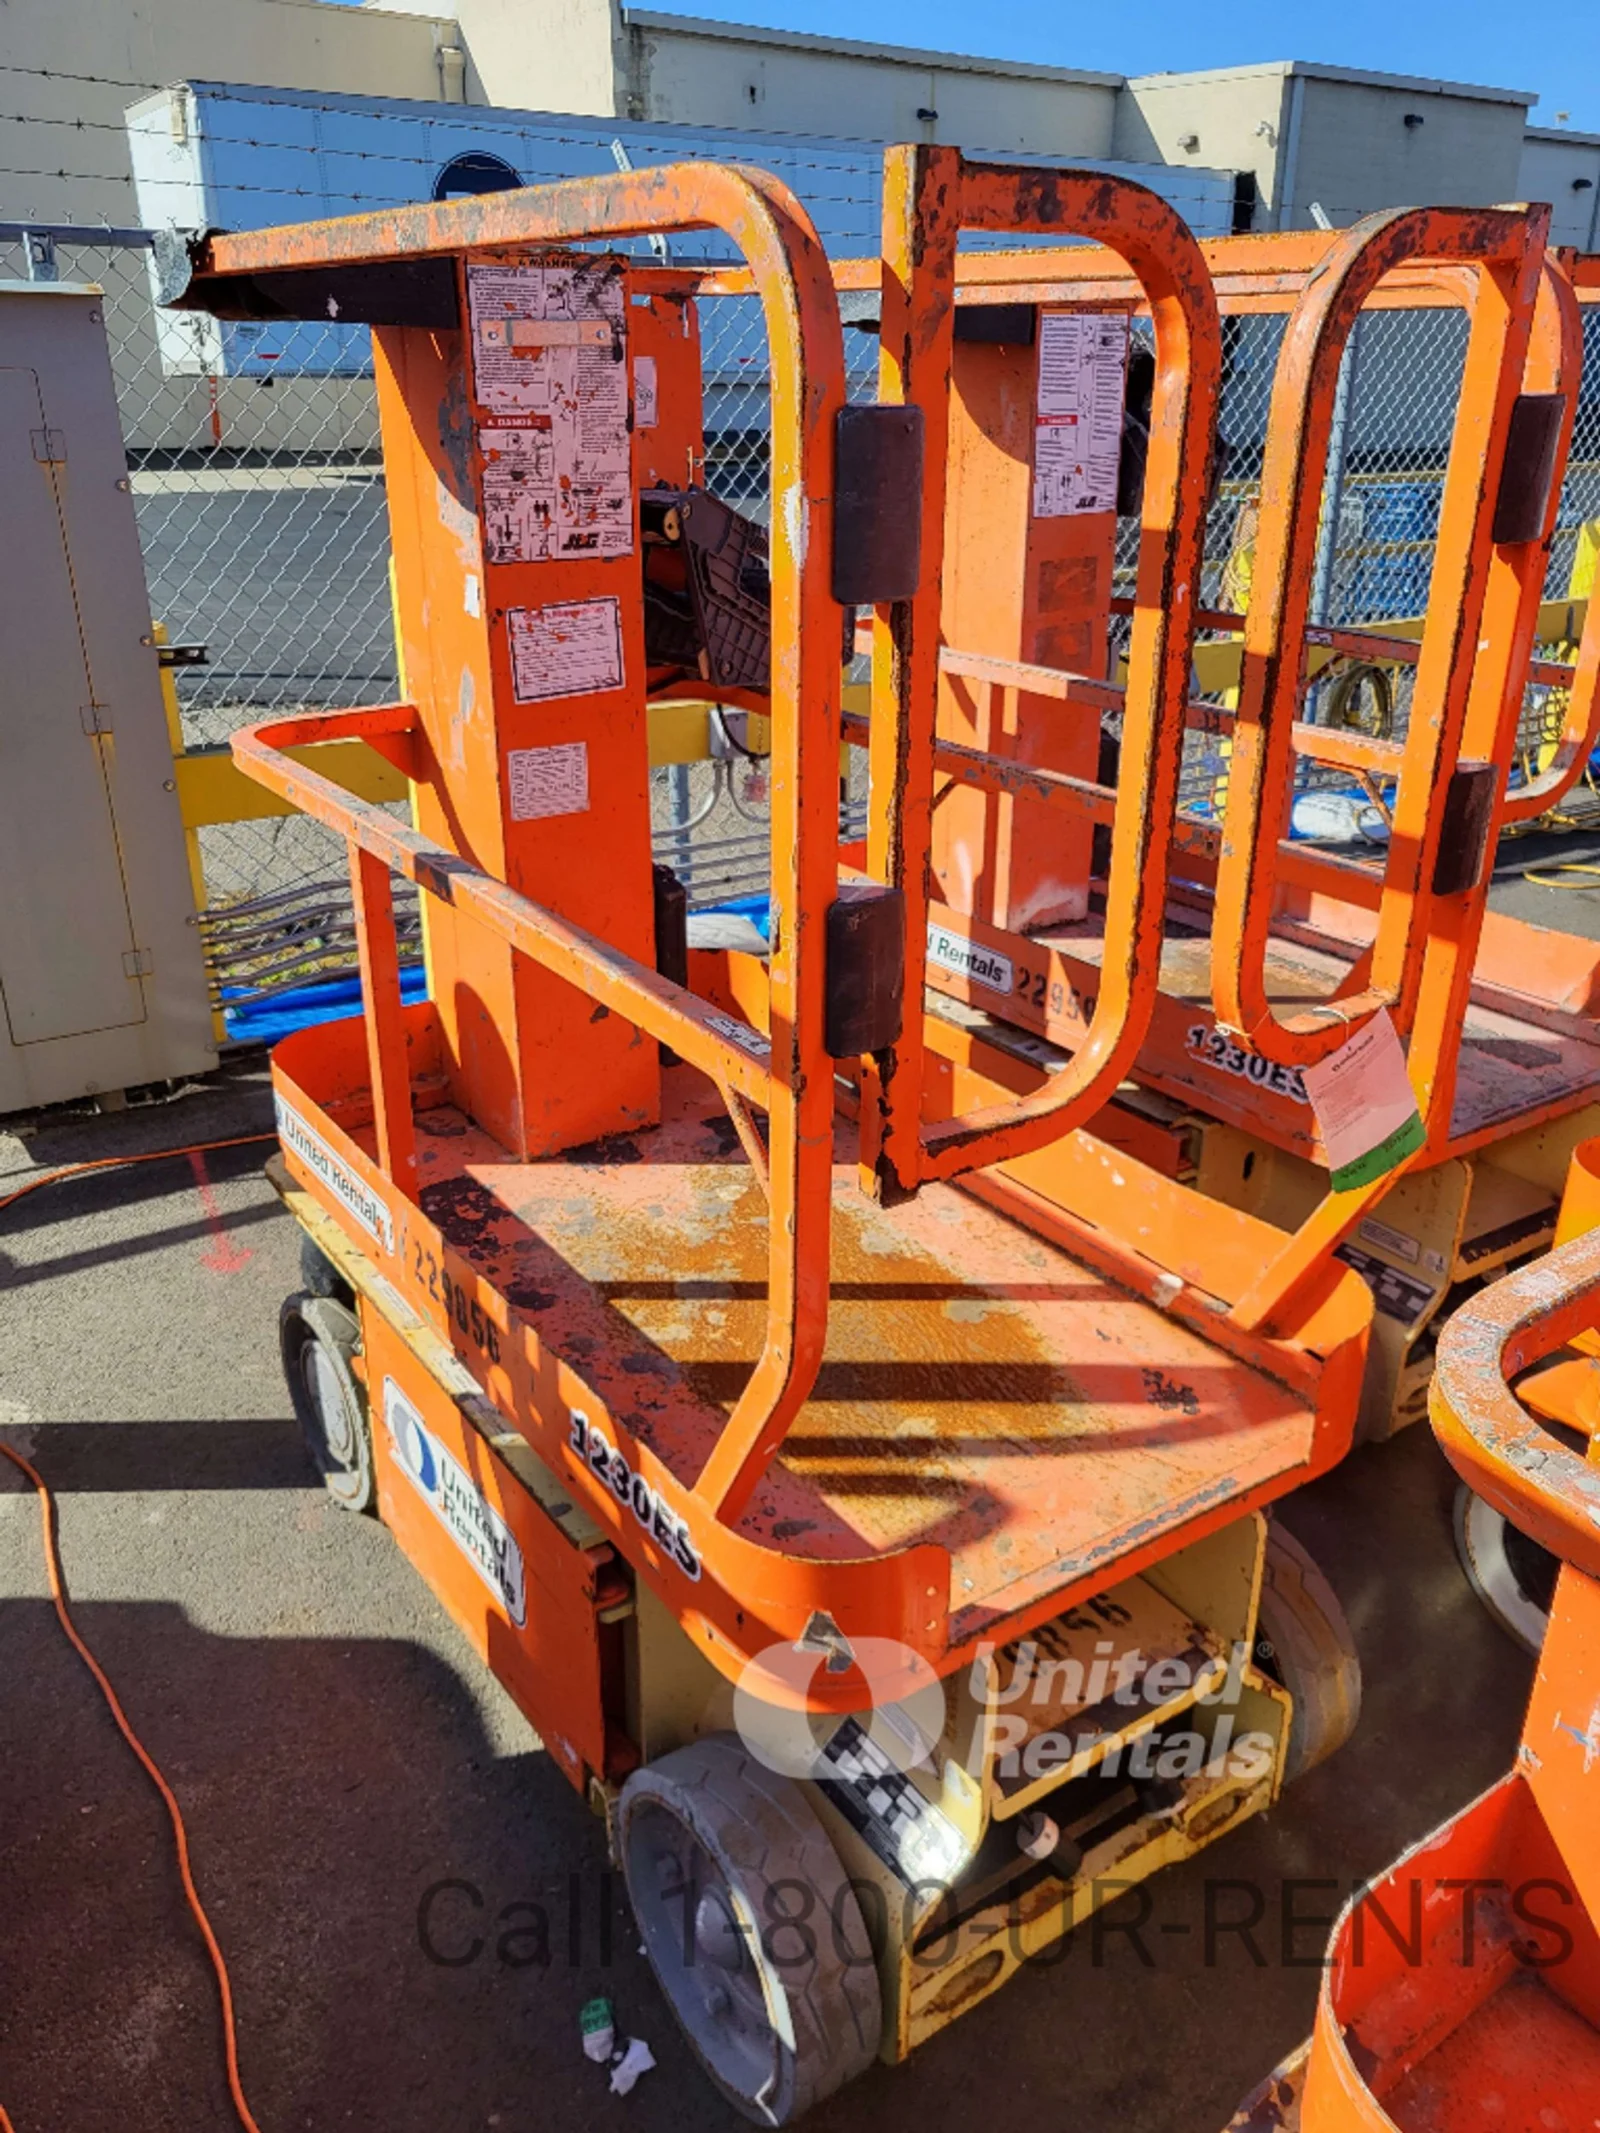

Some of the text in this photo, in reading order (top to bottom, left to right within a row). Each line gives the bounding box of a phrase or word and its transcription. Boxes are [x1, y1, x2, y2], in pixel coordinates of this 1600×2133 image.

[936, 936, 1005, 984] Rentals
[284, 1111, 384, 1239] United Rental
[440, 1457, 507, 1562] United
[441, 1491, 517, 1606] Rentals
[571, 1412, 700, 1578] 1230ES
